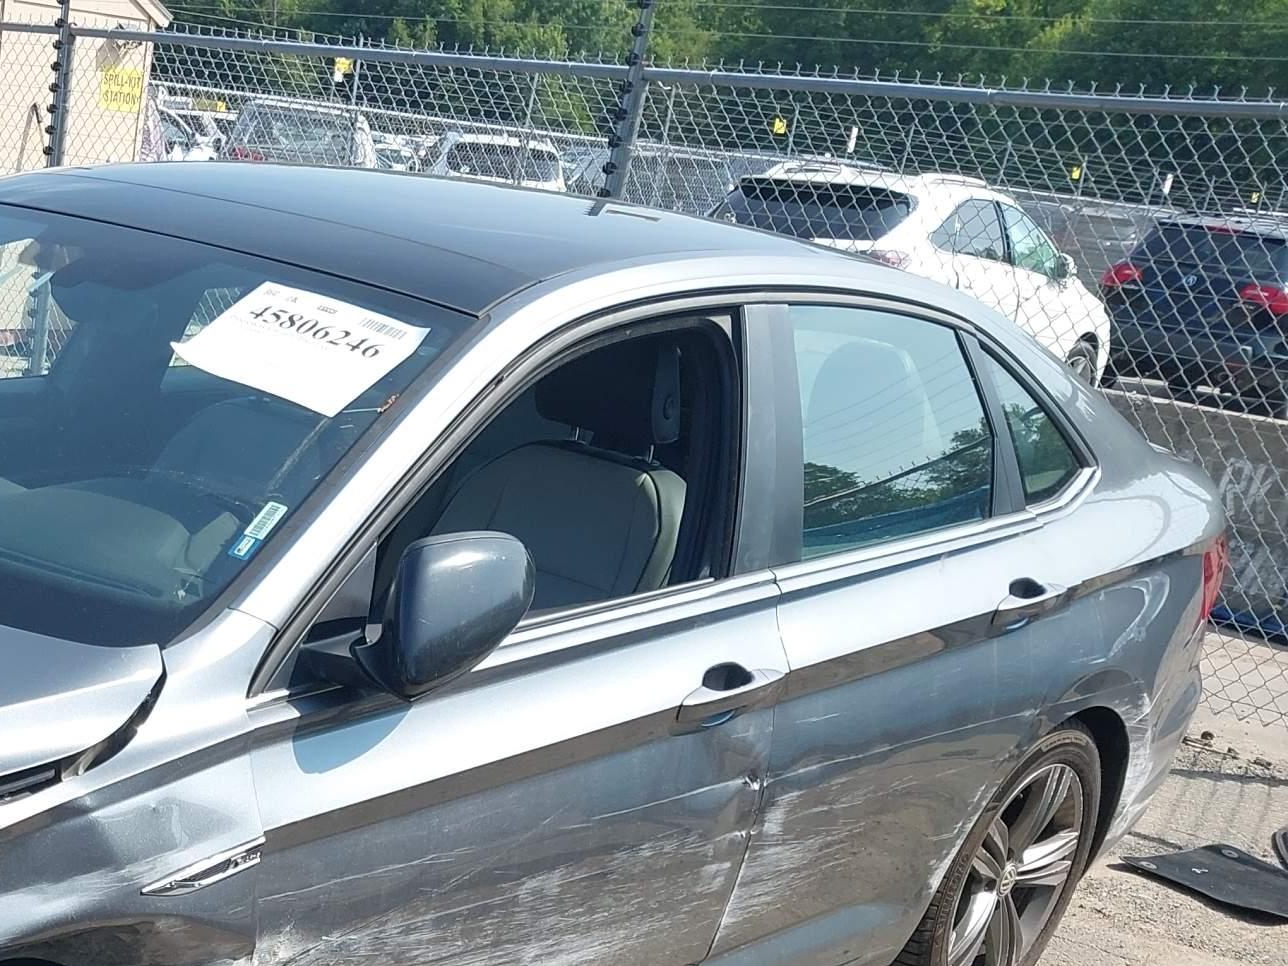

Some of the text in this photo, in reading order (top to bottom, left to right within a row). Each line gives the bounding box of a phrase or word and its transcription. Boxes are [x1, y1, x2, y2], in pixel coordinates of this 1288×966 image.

[103, 73, 142, 89] SPILL-KIT
[102, 90, 137, 106] STATION
[249, 305, 381, 359] 45806246
